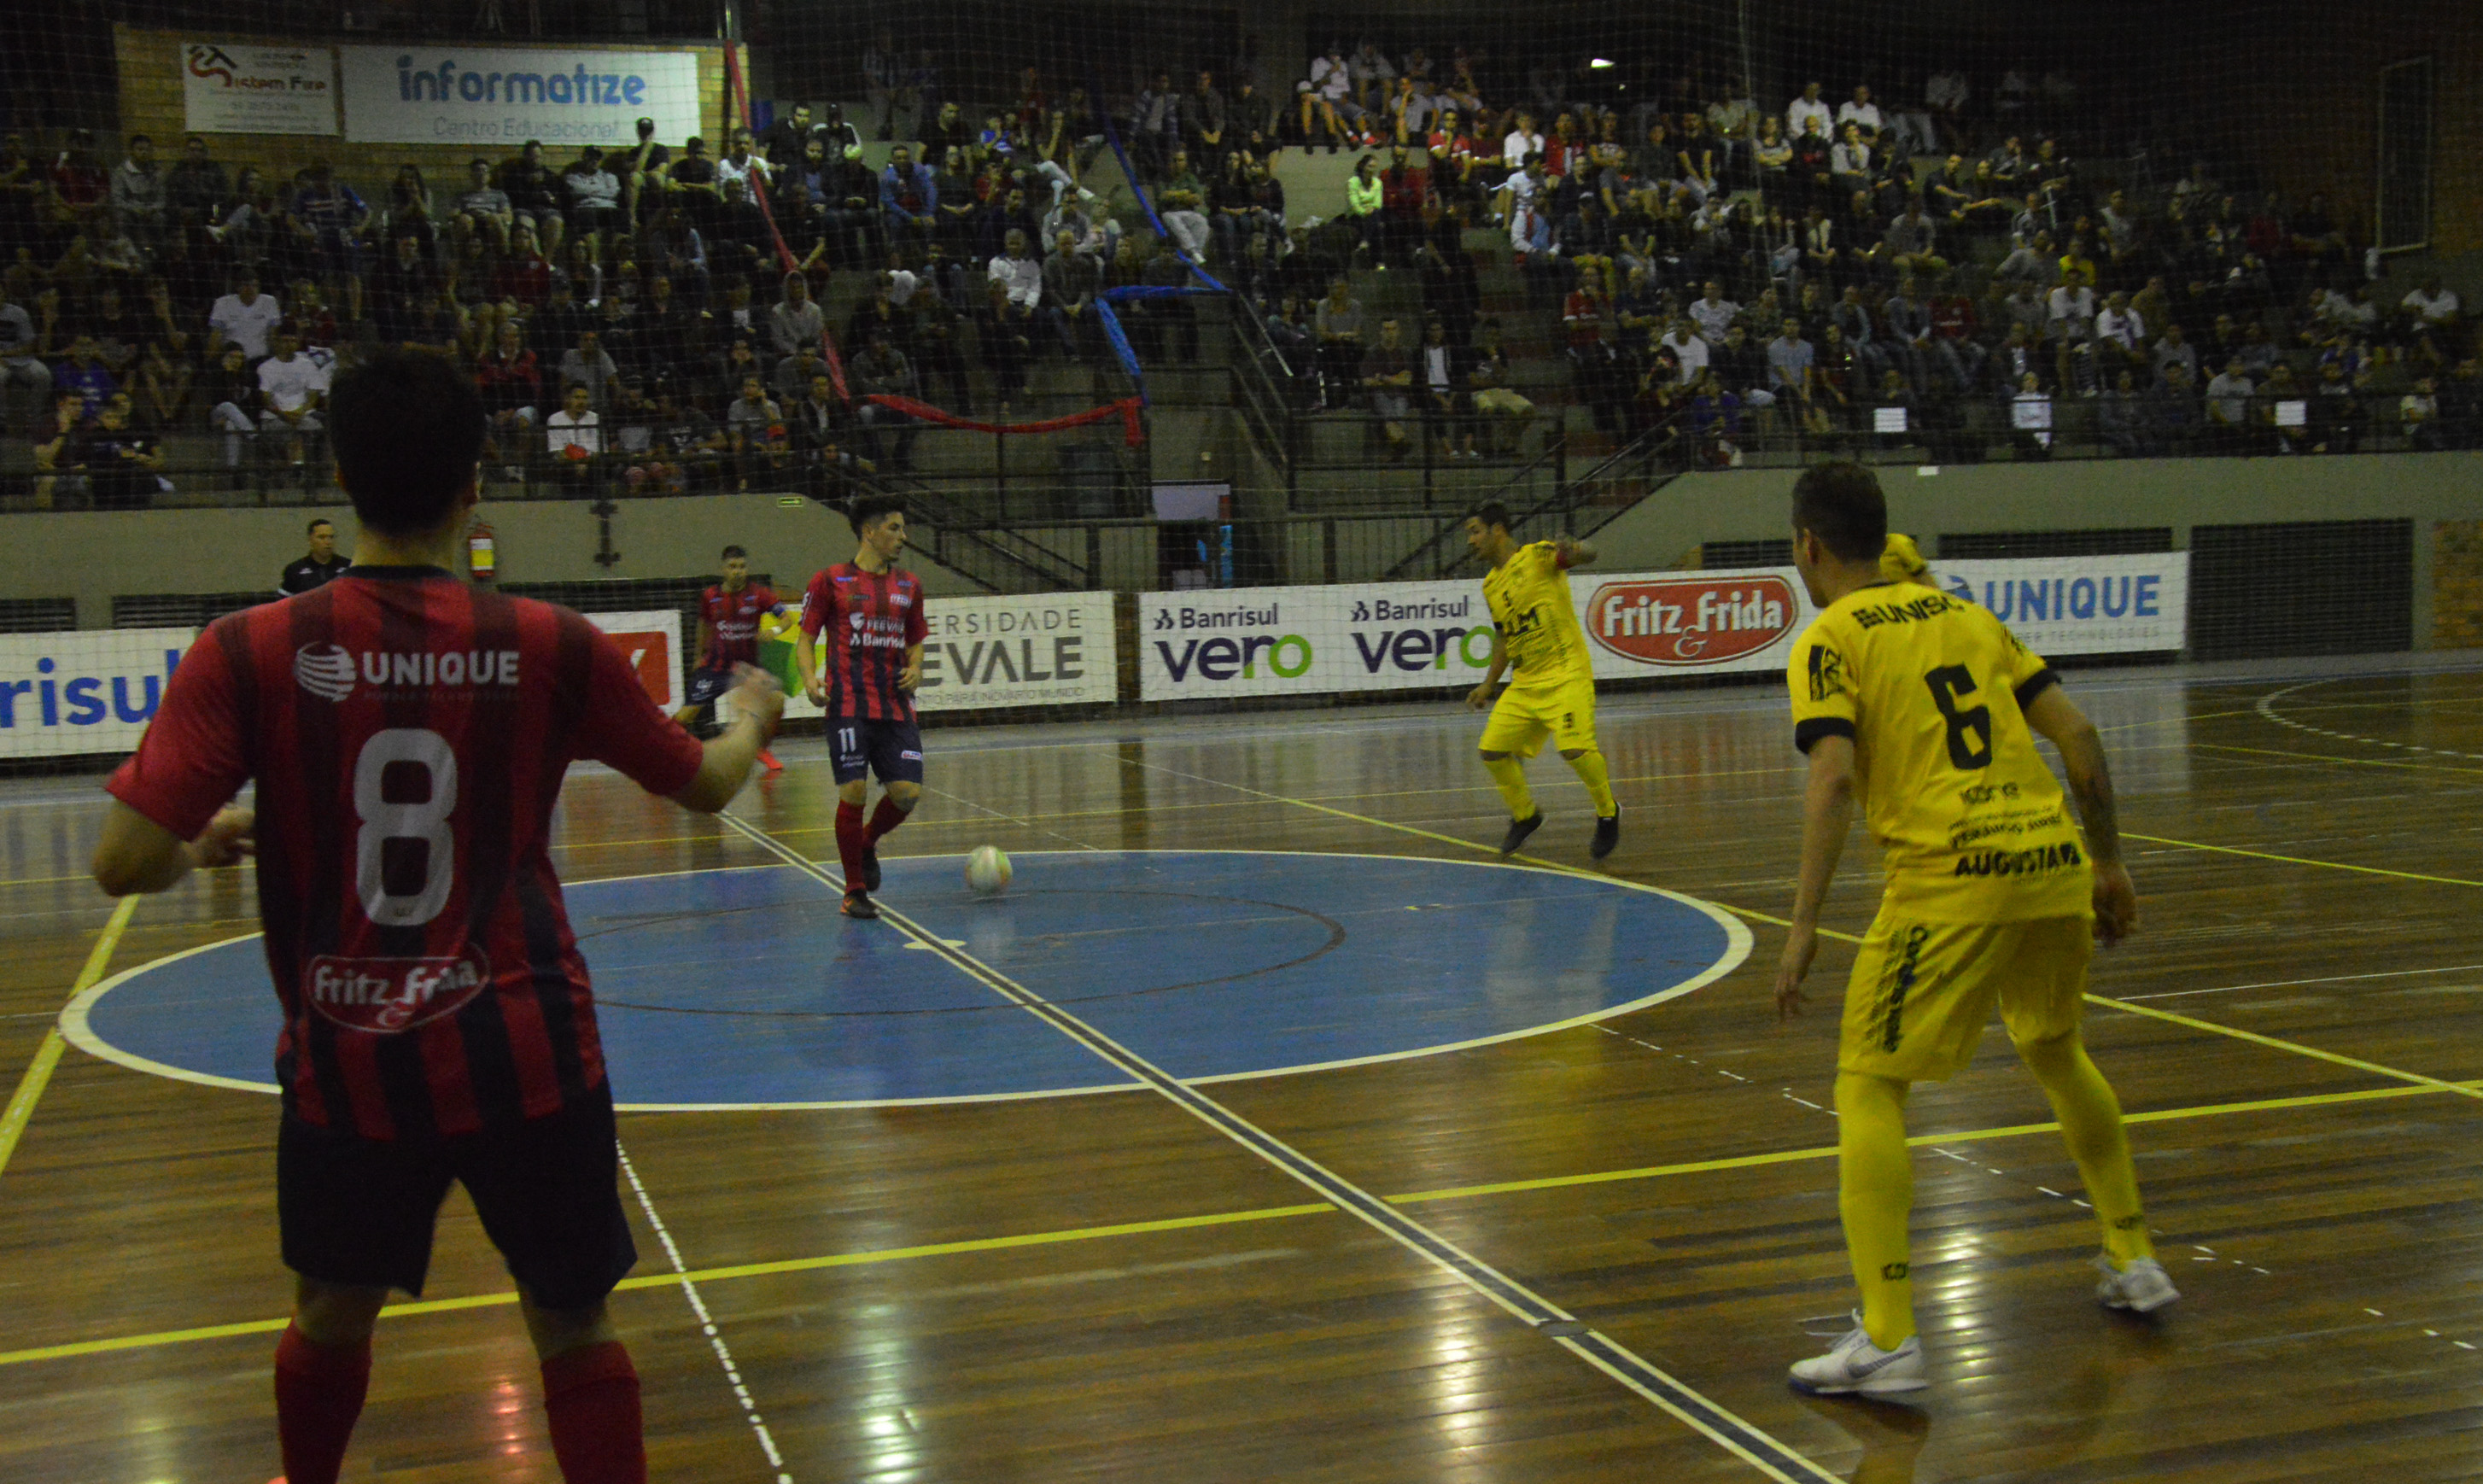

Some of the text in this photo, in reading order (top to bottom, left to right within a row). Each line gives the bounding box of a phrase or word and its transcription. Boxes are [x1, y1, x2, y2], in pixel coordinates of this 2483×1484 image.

[397, 54, 646, 105] informatize
[433, 117, 618, 139] Centro Educacional
[926, 609, 1082, 635] ERSIDADE
[1181, 603, 1277, 628] Banrisul
[1376, 595, 1468, 622] Banrisul
[1985, 575, 2160, 622] UNIQUE
[1603, 589, 1785, 658] Fritz & Frida
[362, 651, 521, 686] UNIQUE
[923, 636, 1084, 686] EVALE
[1154, 634, 1312, 682] vero
[1351, 626, 1495, 673] vero
[838, 727, 856, 753] 11
[1925, 663, 1992, 770] 6
[353, 727, 459, 926] 8
